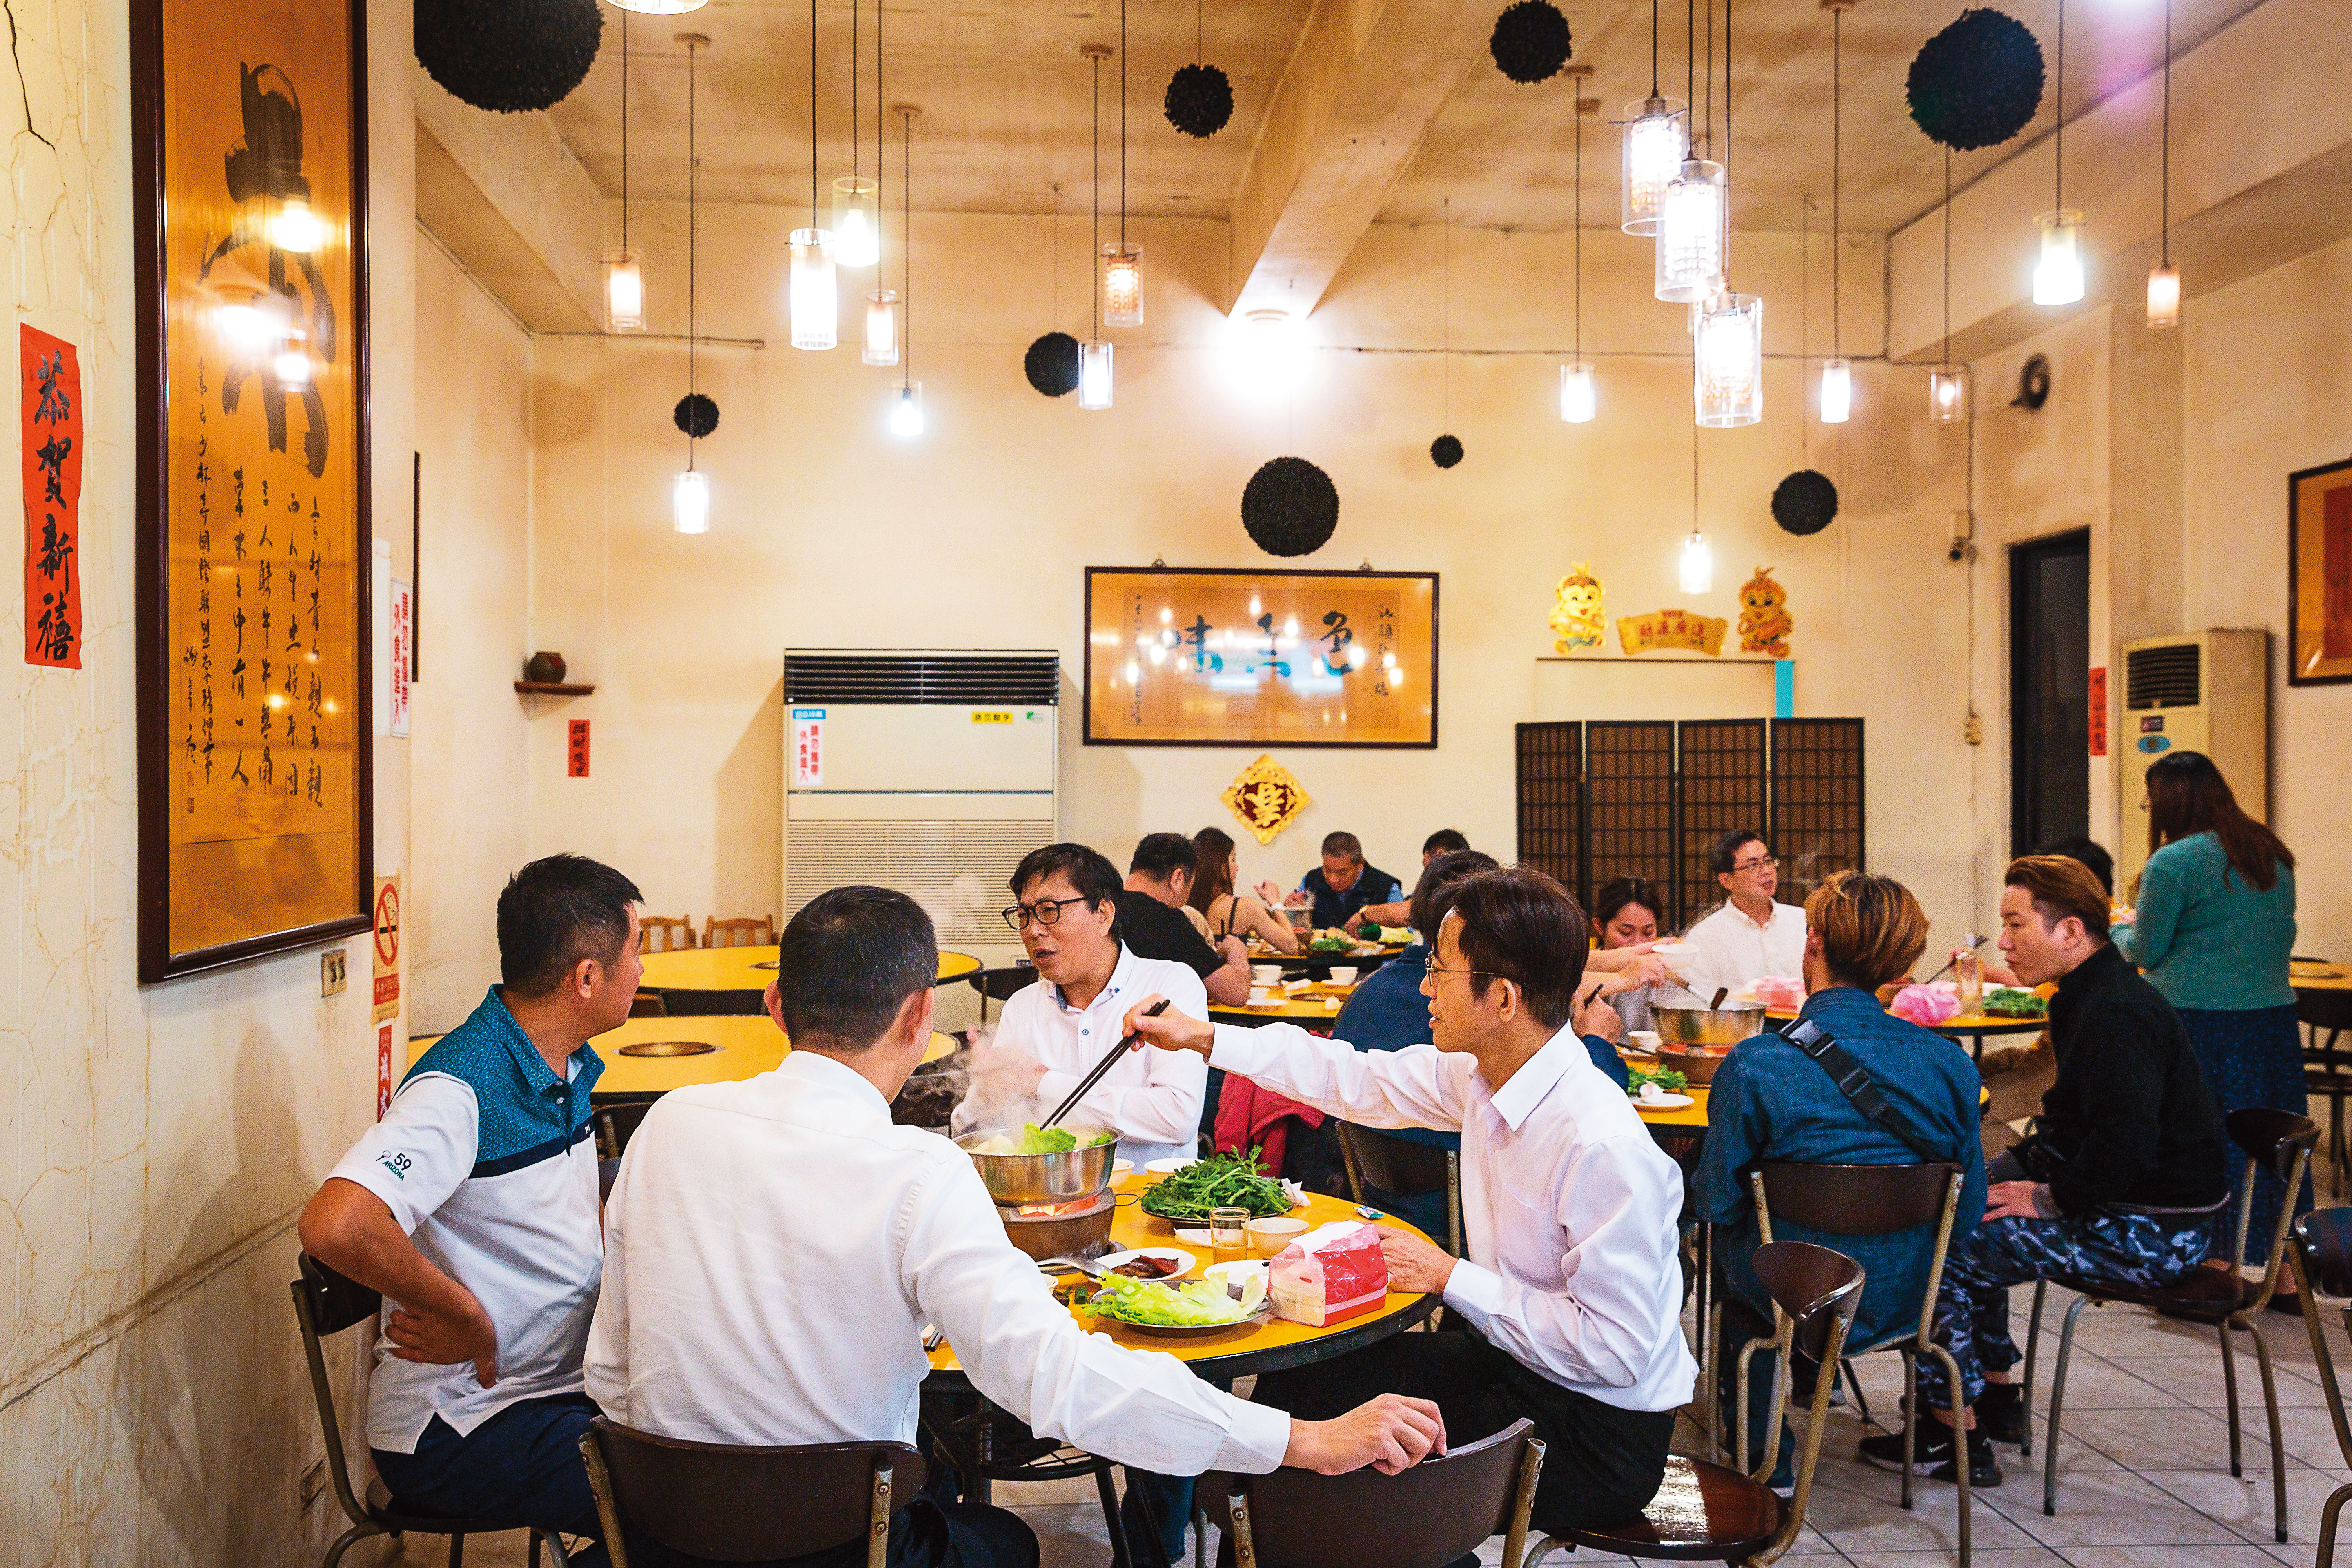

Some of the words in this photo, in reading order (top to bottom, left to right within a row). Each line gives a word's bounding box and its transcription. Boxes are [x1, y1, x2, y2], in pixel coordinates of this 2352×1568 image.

[34, 349, 74, 661] 恭賀新禧
[382, 1160, 405, 1181] ARIZONA
[394, 1152, 412, 1171] 59
